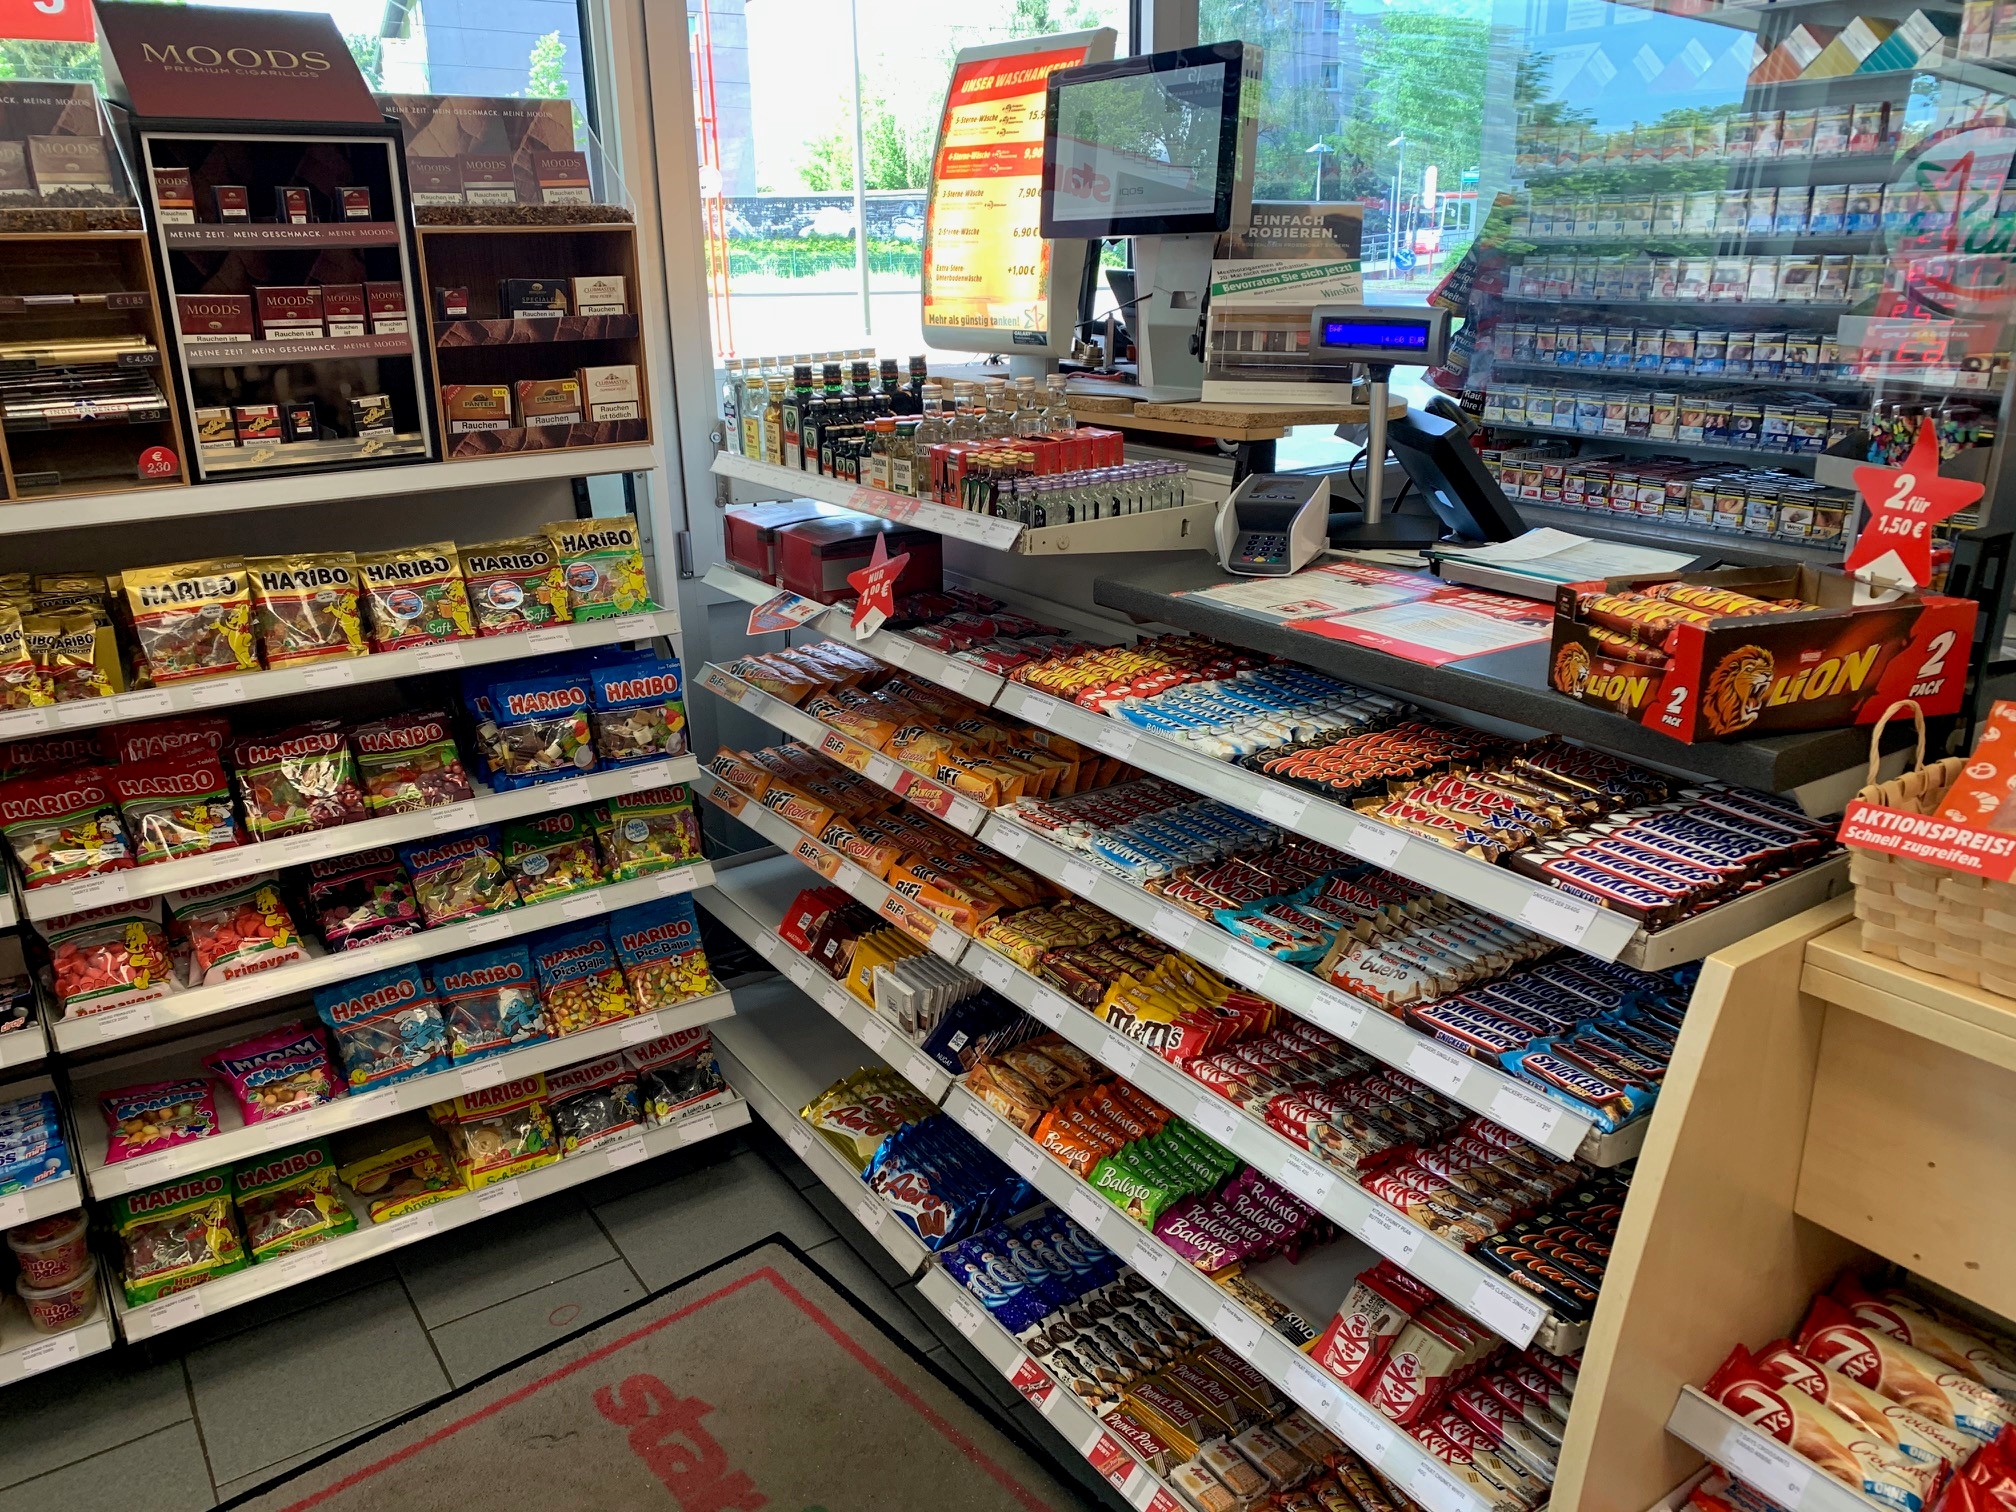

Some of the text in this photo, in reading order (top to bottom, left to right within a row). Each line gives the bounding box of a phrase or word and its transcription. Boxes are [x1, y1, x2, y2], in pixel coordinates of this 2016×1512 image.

[140, 43, 331, 71] MOODS
[164, 65, 319, 78] PREMIUM CIGARILLOS
[961, 78, 992, 94] UNSER
[23, 97, 51, 105] MEINE
[55, 98, 90, 106] MOODS
[955, 113, 998, 124] 5-Sterne-Wäsche
[38, 143, 99, 155] MOODS
[948, 151, 991, 161] 4-Sterne-Wäsche
[416, 164, 451, 172] MOODS
[466, 161, 507, 169] MOODS
[541, 159, 581, 168] MOODS
[942, 189, 984, 198] 3-Sterne-Wäsche
[1119, 185, 1144, 197] IQOS
[1253, 215, 1324, 225] EINFACH
[170, 231, 200, 239] MEINE
[205, 231, 228, 239] ZEIT.
[233, 231, 259, 239] MEIN
[262, 230, 324, 239] GESCHMACK.
[360, 228, 393, 237] MOODS
[936, 274, 982, 283] Unterbodenwäsche
[1029, 266, 1035, 275] €
[1222, 277, 1280, 292] Bevorraten
[1282, 274, 1298, 282] Sie
[1302, 269, 1323, 278] sich
[1325, 264, 1353, 276] jetzt!
[266, 296, 314, 306] MOODS
[1321, 286, 1359, 298] Winston
[187, 304, 240, 315] MOODS
[929, 314, 1020, 328] Mehr als günstig tanken!
[280, 345, 339, 353] GESCHMACK.
[374, 340, 407, 348] MOODS
[1409, 336, 1424, 345] EUR
[50, 406, 122, 414] INDEPENDENCE
[535, 415, 569, 424] Rauchen
[152, 451, 162, 461] €
[147, 462, 170, 472] 2,30
[1884, 474, 1931, 514] 2 für
[1878, 515, 1927, 538] 1,50 €
[562, 529, 632, 552] HARIBO
[368, 556, 449, 582] HARIBO
[471, 552, 548, 572] HARIBO
[260, 567, 348, 591] HARIBO
[868, 569, 884, 582] NUR
[527, 607, 550, 621] Saft
[429, 620, 452, 634] Saft
[1917, 630, 1957, 678] 2
[708, 673, 726, 688] BiFi
[1766, 644, 1881, 708] LION
[606, 674, 678, 702] HARIBO
[1586, 674, 1649, 708] LION
[1909, 678, 1945, 698] PACK
[509, 686, 586, 714] HARIBO
[1666, 687, 1688, 714] 2
[1661, 712, 1683, 729] PACK
[825, 735, 846, 754] BiFi
[119, 771, 214, 794] HARIBO
[712, 784, 731, 802] BiFi
[908, 784, 944, 804] RANGER
[3, 788, 105, 819] HARIBO
[1381, 801, 1506, 854] TWIX Xtra
[1850, 806, 2016, 858] AKTIONSPREIS!
[798, 841, 820, 861] BiFi
[1097, 836, 1148, 867] BOUNTY
[1845, 824, 1983, 869] Schnell zugreifen.
[1556, 860, 1674, 907] SNICKERS
[1164, 880, 1229, 909] TWIX
[1533, 892, 1554, 903] SNICKERS
[885, 899, 906, 917] BiFi
[1428, 931, 1450, 948] kinder
[224, 950, 300, 981] Primavera
[1360, 957, 1408, 981] bueno
[1378, 953, 1399, 969] kinder
[445, 963, 523, 990] HARIBO
[1, 1016, 24, 1032] drop
[1417, 1041, 1436, 1055] SNICKERS
[1436, 1050, 1451, 1062] SINGLE
[1436, 1032, 1470, 1051] SNICKERS
[234, 1036, 317, 1071] MAOAM
[246, 1057, 326, 1087] KRACHER
[1531, 1054, 1618, 1097] SNICKERS
[1502, 1085, 1523, 1098] SNICKERS
[1523, 1095, 1536, 1105] CRISP
[1041, 1130, 1092, 1163] Balisto
[237, 1149, 322, 1189] HARIBO
[882, 1173, 940, 1210] Aero
[1101, 1166, 1150, 1200] Balisto
[129, 1176, 223, 1213] HARIBO
[1165, 1217, 1227, 1257] Balisto
[33, 1262, 69, 1281] pack
[174, 1272, 209, 1287] Happy
[1483, 1280, 1494, 1290] MARS
[1495, 1287, 1512, 1301] CLASSIC
[1512, 1299, 1528, 1311] SINGLE
[33, 1304, 69, 1318] Auto
[46, 1305, 82, 1326] pack
[1285, 1311, 1316, 1341] KIND
[1331, 1314, 1370, 1376] KitKat
[1380, 1353, 1420, 1418] KitKat
[1106, 1413, 1137, 1437] PRINCE
[1134, 1432, 1159, 1453] POLO
[1883, 1405, 1967, 1457] Croissant
